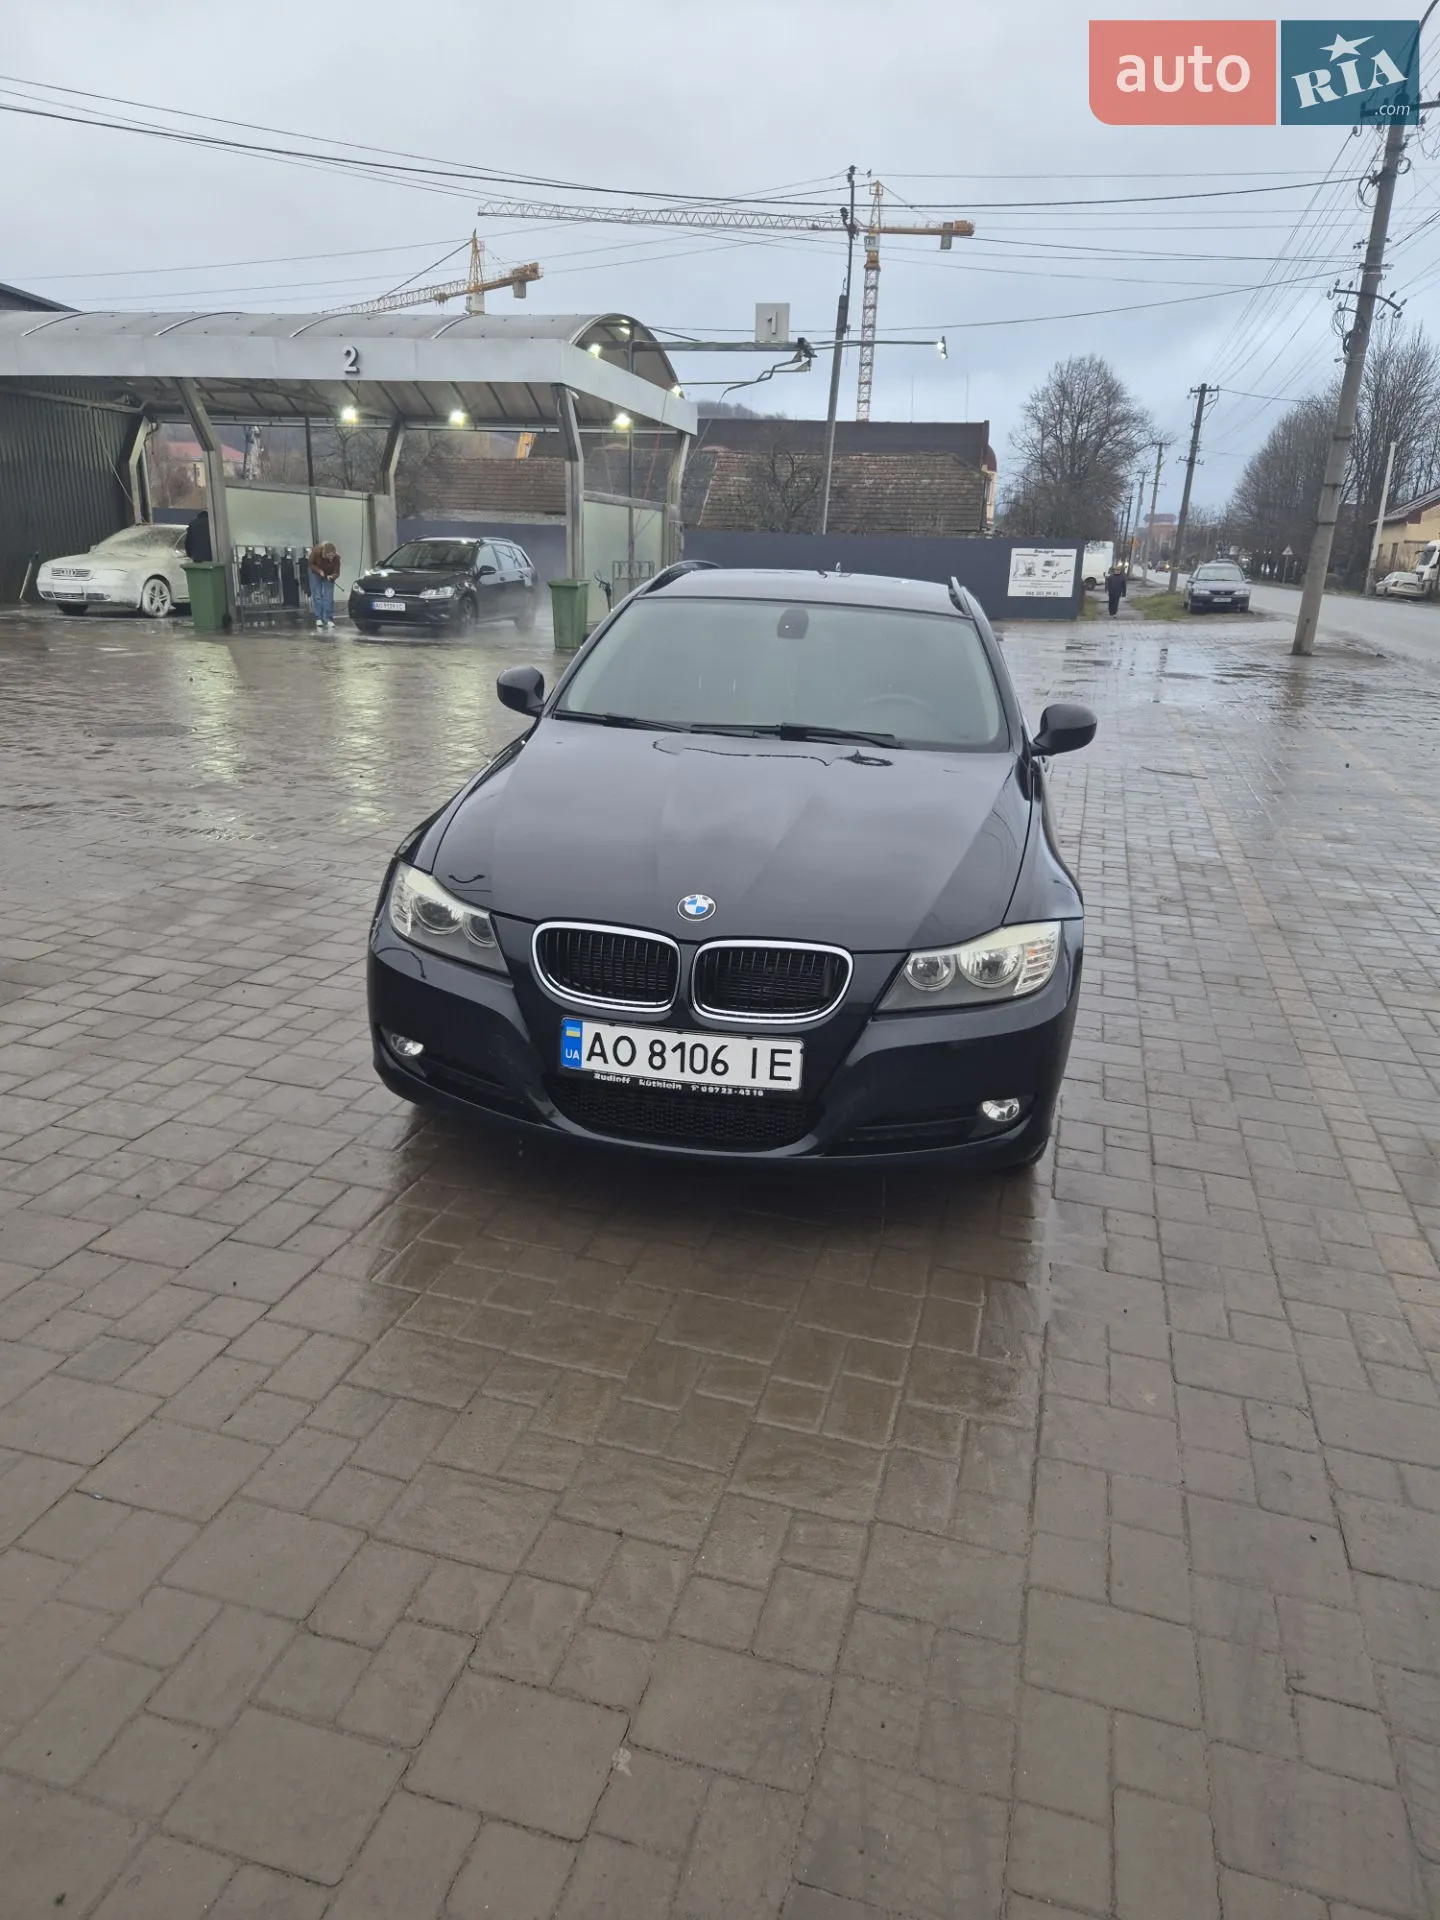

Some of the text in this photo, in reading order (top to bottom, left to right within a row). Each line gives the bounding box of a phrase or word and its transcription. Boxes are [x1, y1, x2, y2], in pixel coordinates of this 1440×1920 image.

[767, 311, 777, 335] 1
[343, 346, 360, 374] 2
[565, 1049, 580, 1060] UA
[586, 1032, 793, 1082] AO 8106 IE
